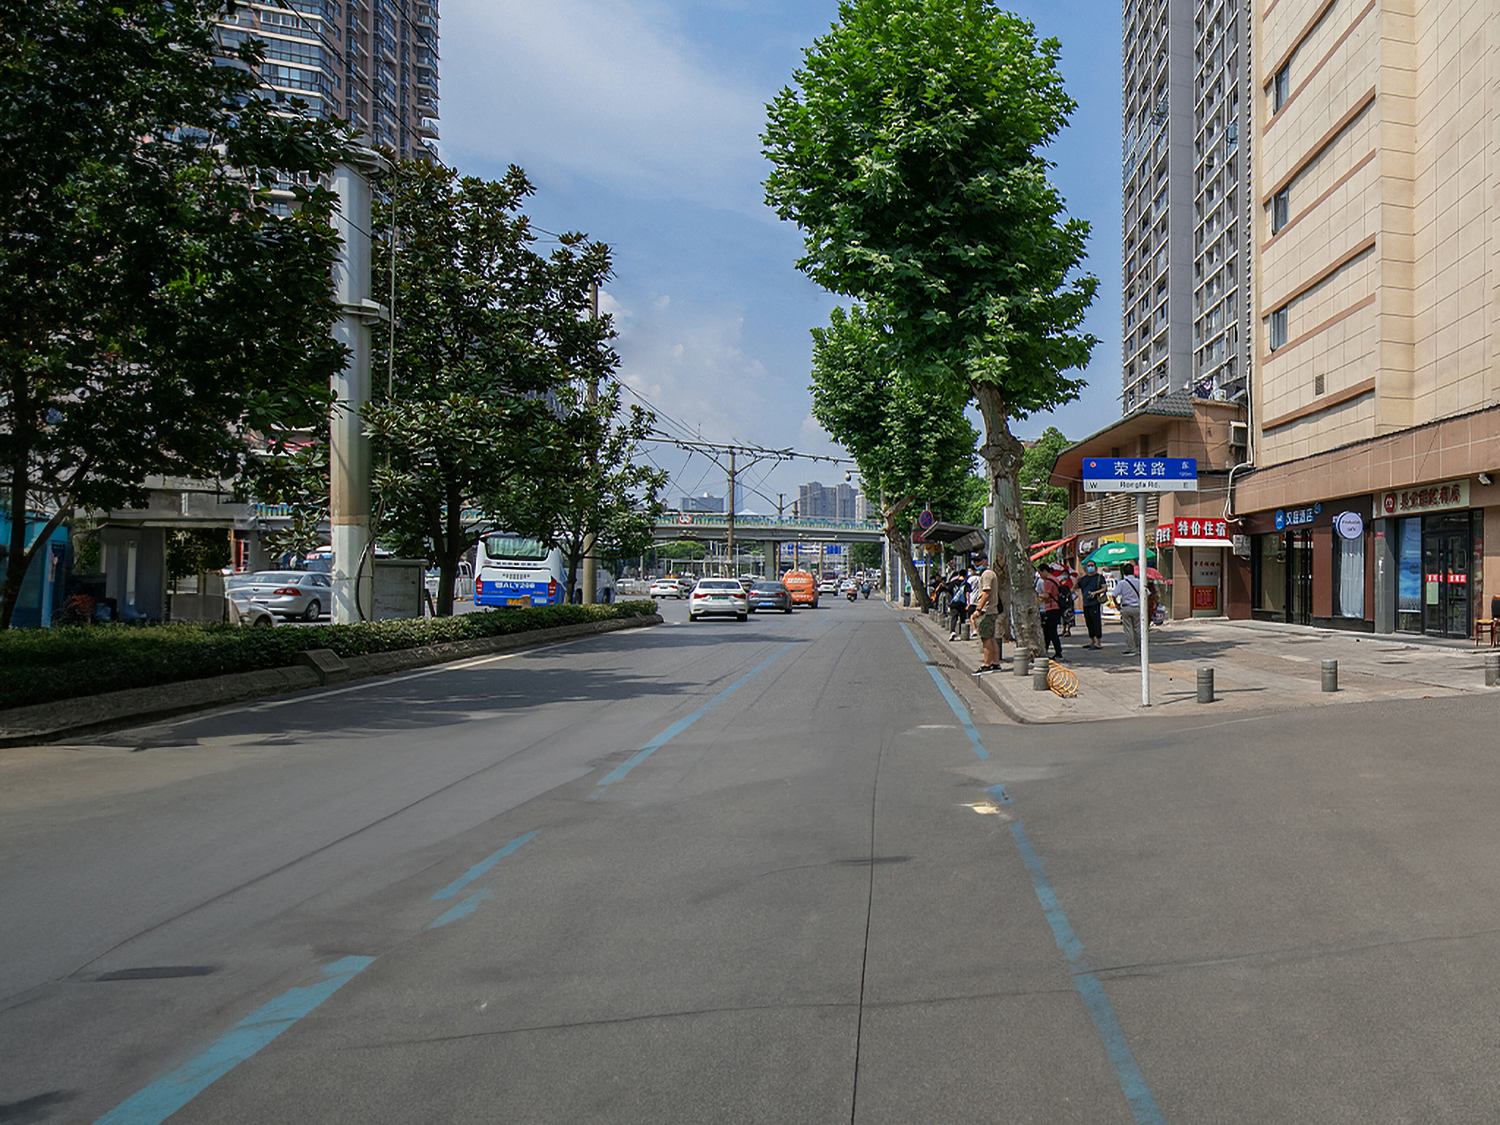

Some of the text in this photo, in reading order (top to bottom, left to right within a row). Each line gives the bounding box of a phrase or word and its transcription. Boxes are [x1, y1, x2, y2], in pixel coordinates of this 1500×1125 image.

[1114, 461, 1165, 476] 荣发路
[1178, 520, 1226, 537] 特价住宿
